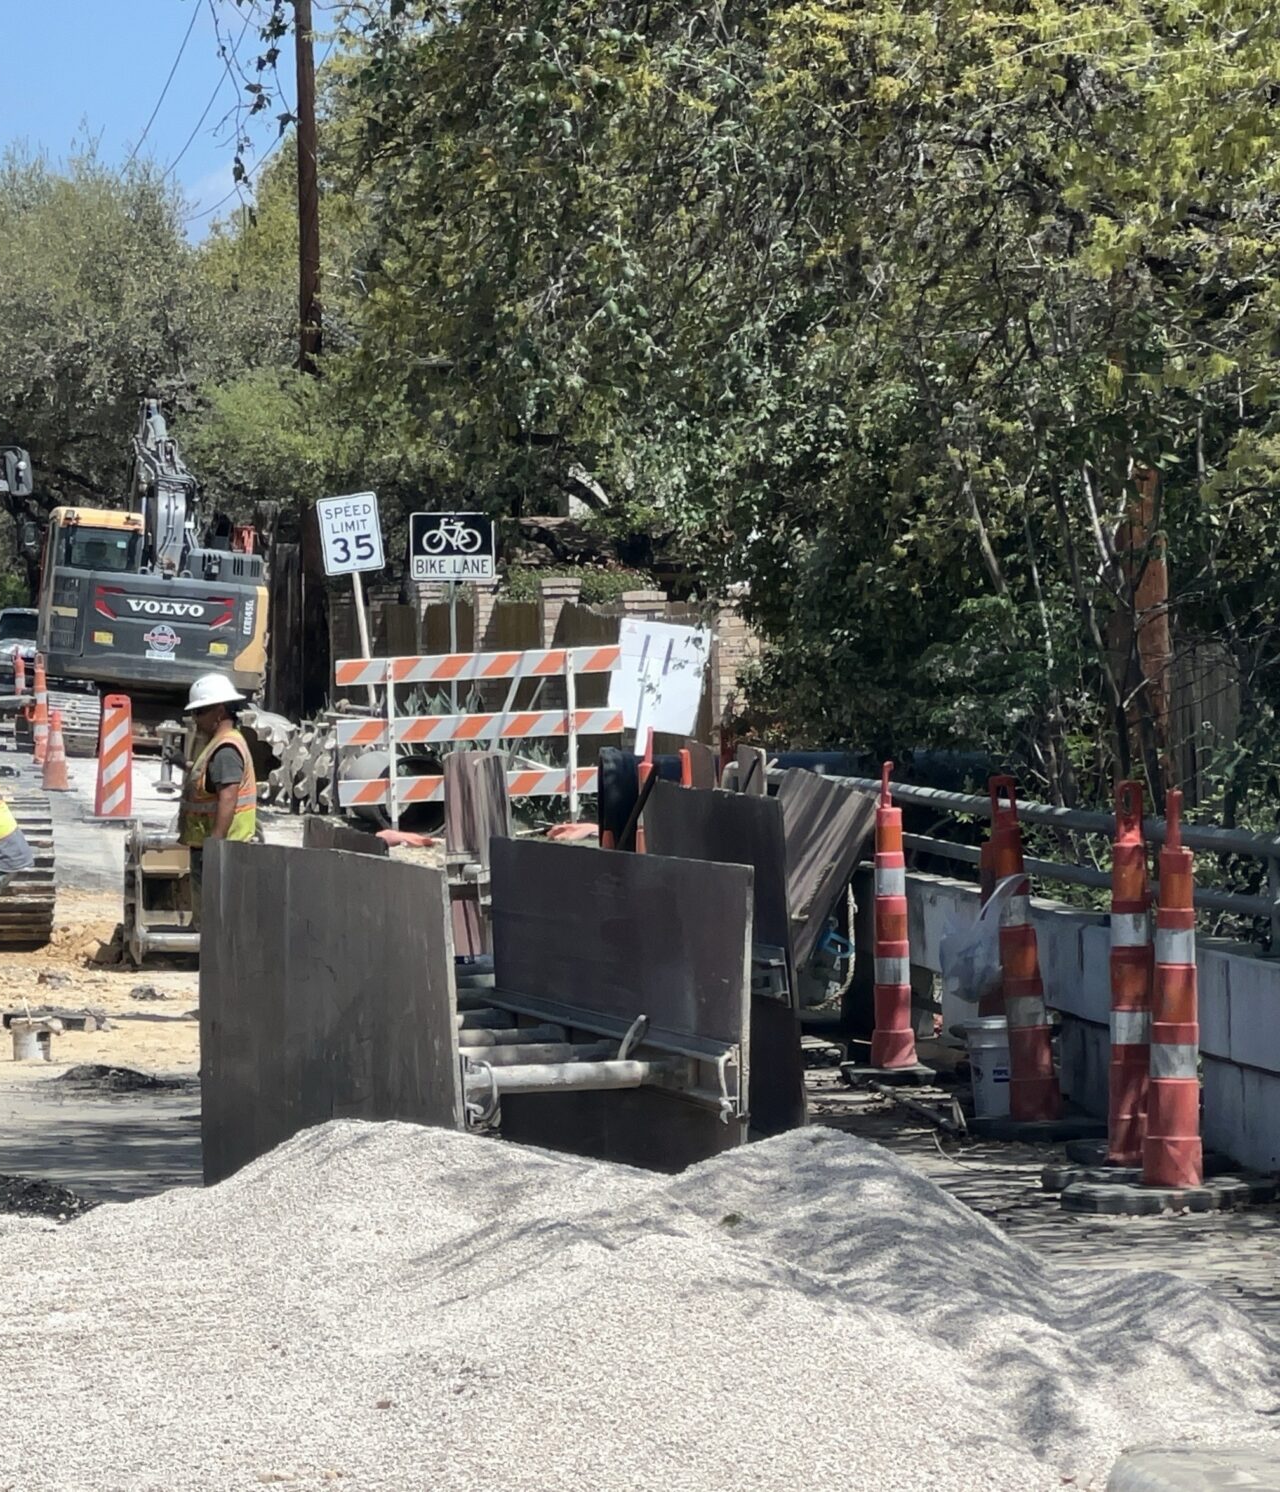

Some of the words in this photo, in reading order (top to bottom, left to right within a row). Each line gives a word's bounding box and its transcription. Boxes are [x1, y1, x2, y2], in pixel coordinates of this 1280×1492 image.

[324, 504, 372, 520] SPEED
[331, 519, 367, 534] LIMIT
[332, 533, 375, 564] 35
[416, 559, 447, 574] BIKE
[452, 559, 489, 574] LANE
[126, 598, 205, 618] VOLVO
